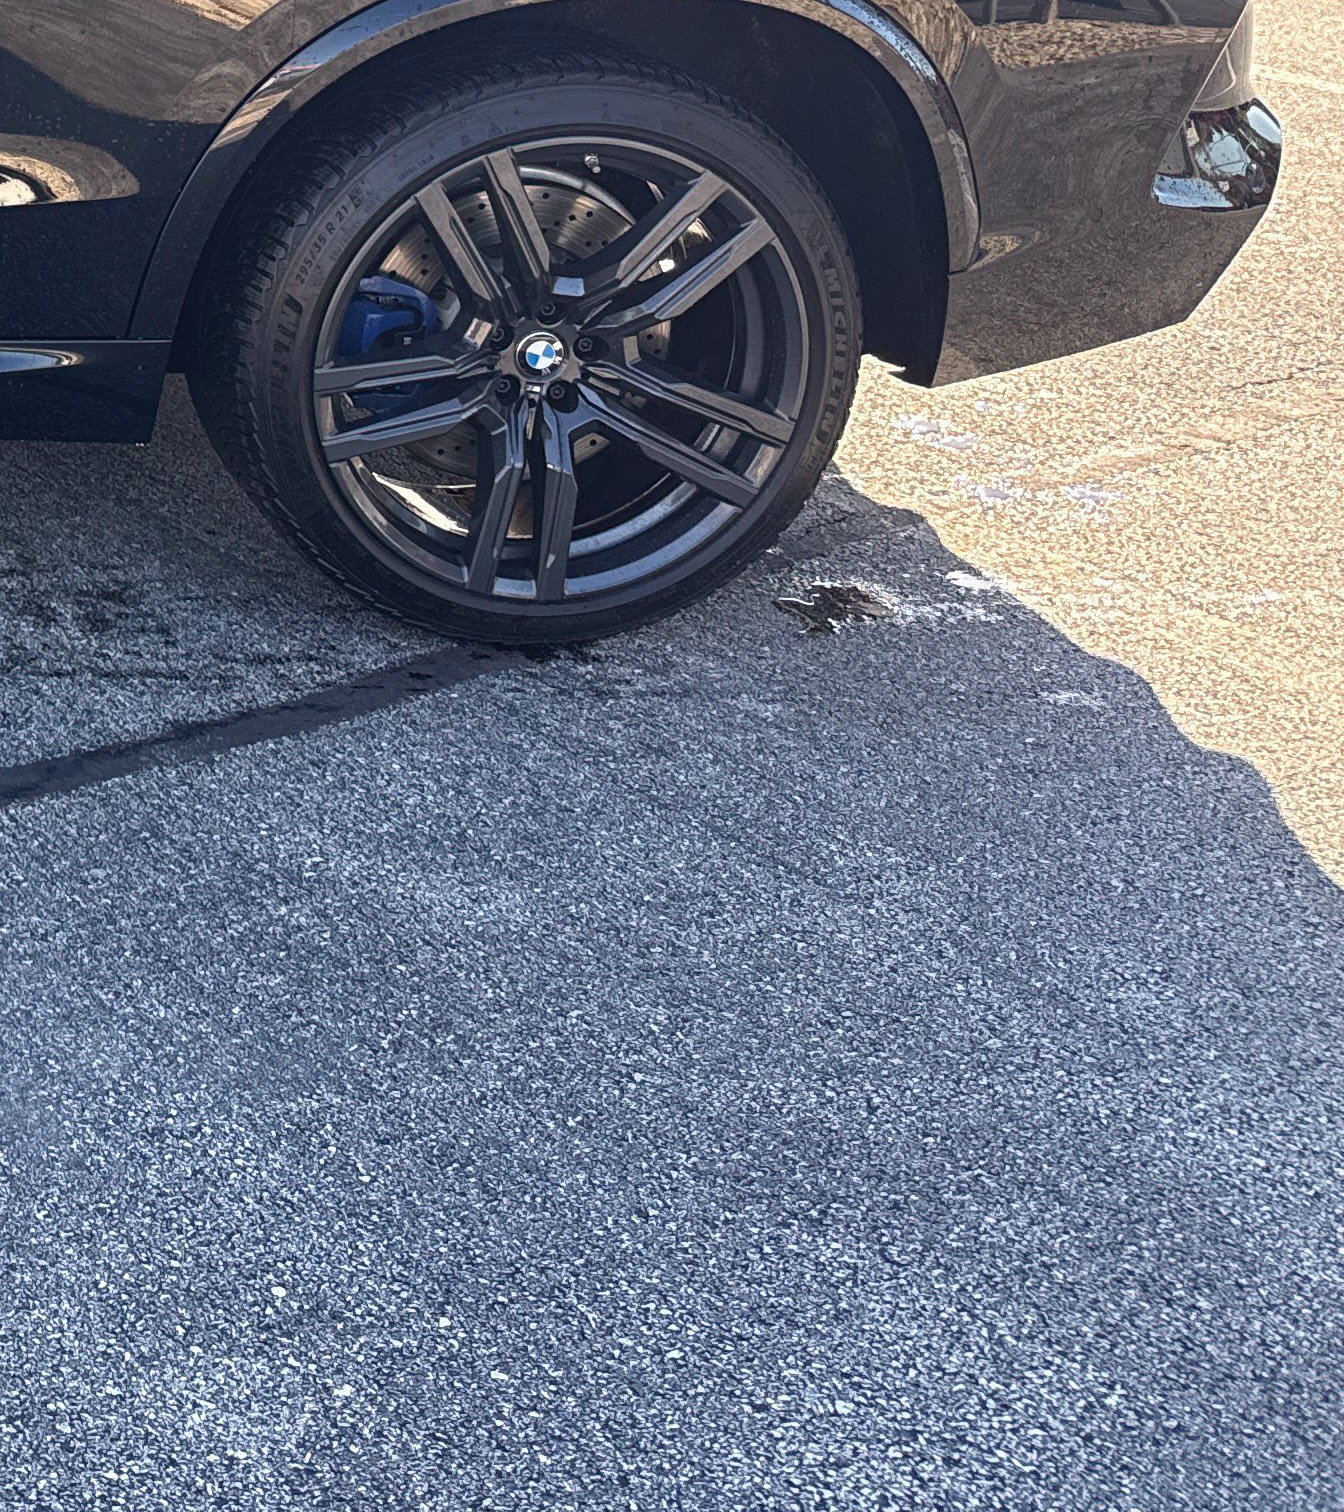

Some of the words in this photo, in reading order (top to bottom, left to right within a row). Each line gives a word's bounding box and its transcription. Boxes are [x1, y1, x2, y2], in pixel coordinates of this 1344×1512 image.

[295, 234, 327, 285] 295/35
[325, 222, 336, 235] R
[335, 205, 349, 223] 21
